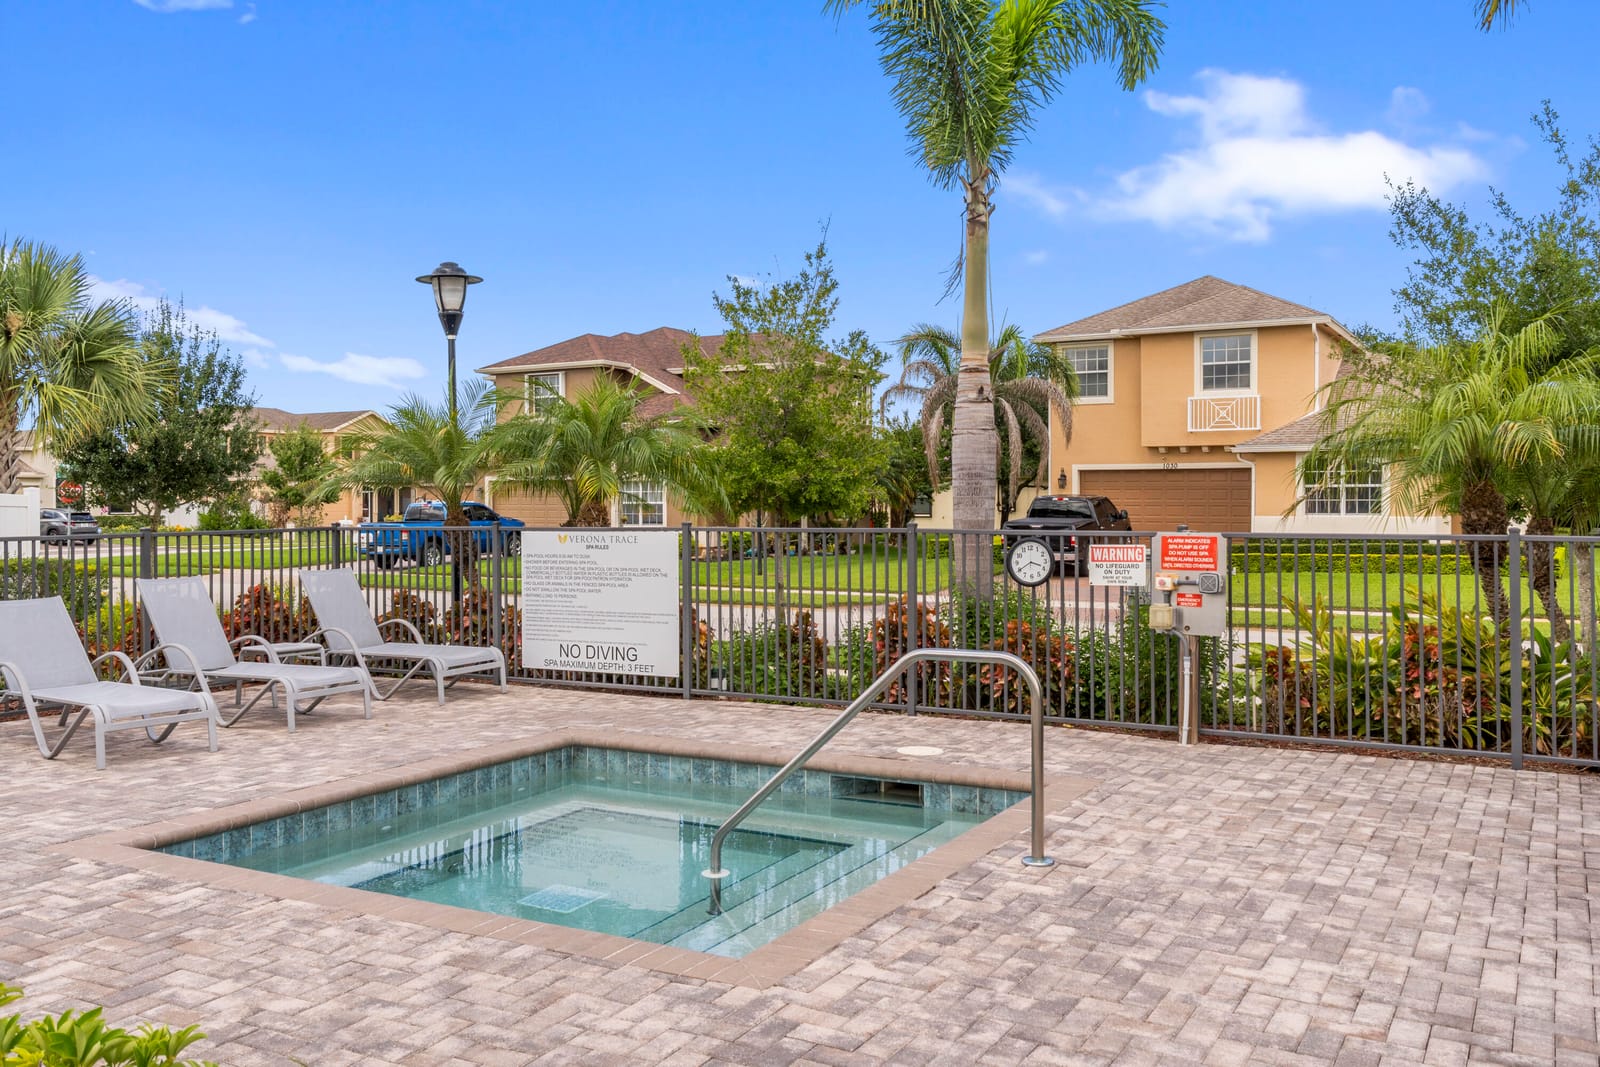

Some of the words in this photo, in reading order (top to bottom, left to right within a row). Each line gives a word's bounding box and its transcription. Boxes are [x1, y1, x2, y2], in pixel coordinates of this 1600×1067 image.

[60, 488, 80, 496] SOP
[1093, 548, 1143, 560] WARNING
[559, 644, 581, 658] NO
[586, 645, 638, 662] DIVING
[544, 659, 558, 667] SPA
[560, 659, 596, 670] MAXIMUM
[598, 662, 626, 672] DEPTH:
[634, 664, 655, 673] FEET
